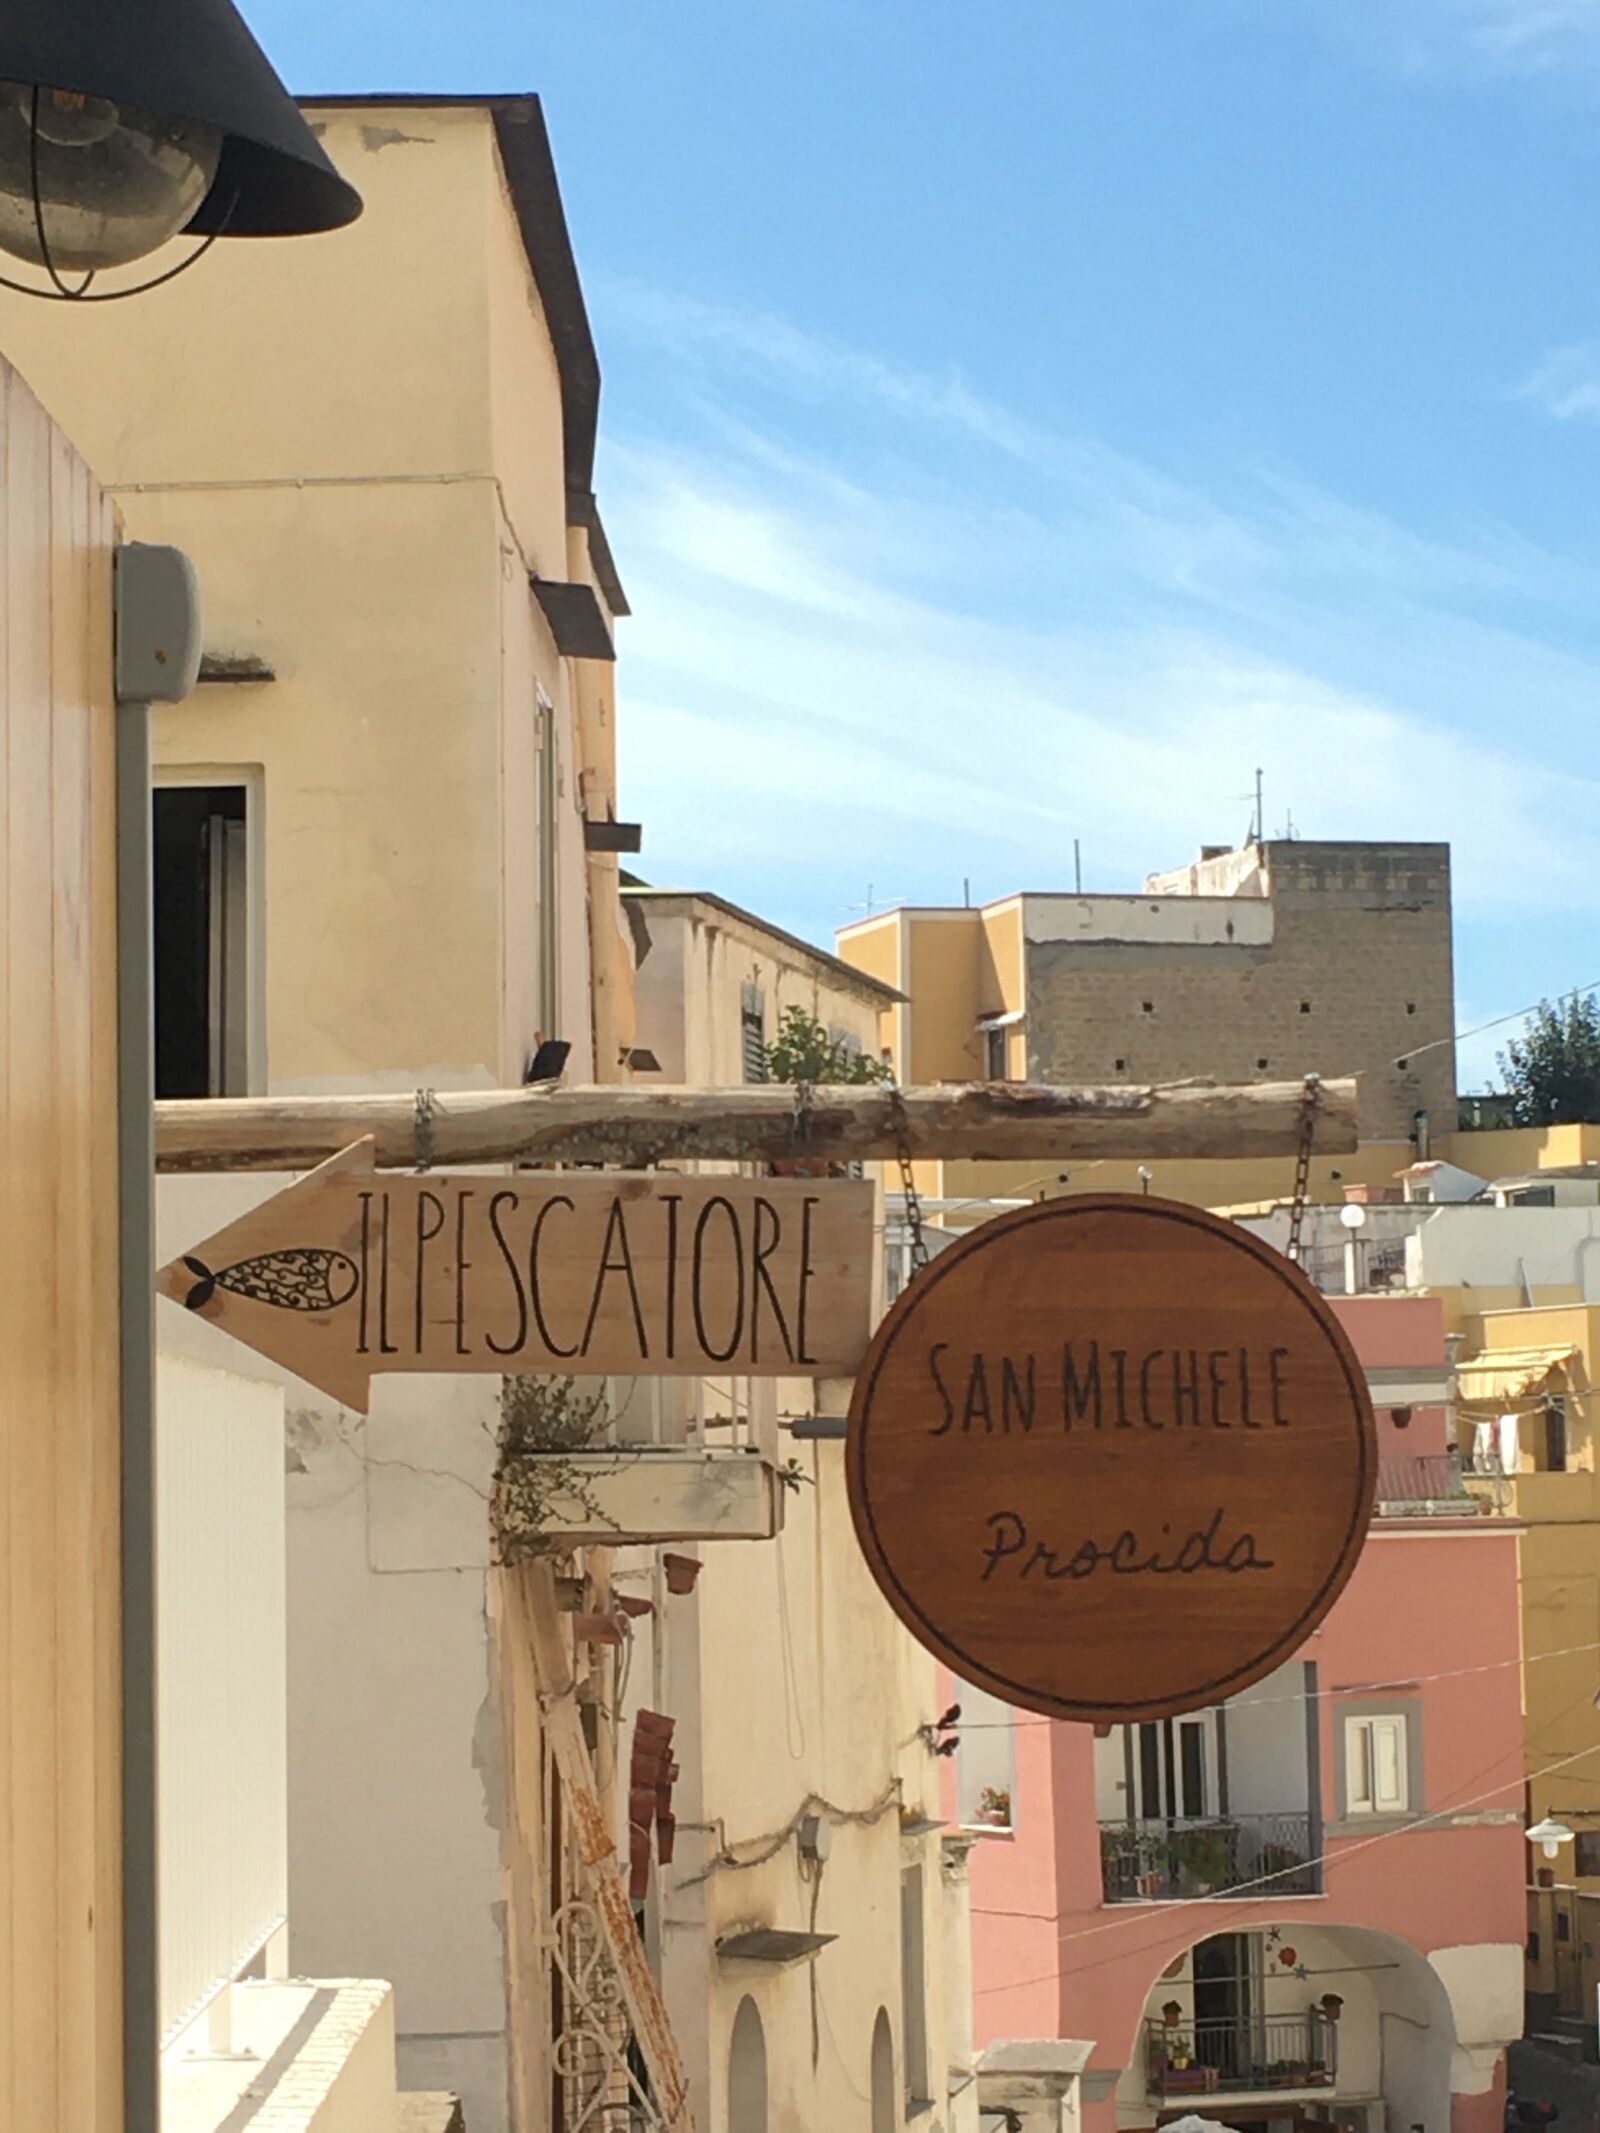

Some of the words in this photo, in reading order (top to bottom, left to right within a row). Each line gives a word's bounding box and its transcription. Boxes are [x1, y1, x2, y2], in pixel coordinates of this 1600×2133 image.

[357, 1191, 398, 1354] IL
[415, 1190, 820, 1364] PESCATORE
[928, 1342, 1036, 1436] SAN
[1062, 1339, 1291, 1433] MICHELE
[979, 1507, 1274, 1582] Procida
